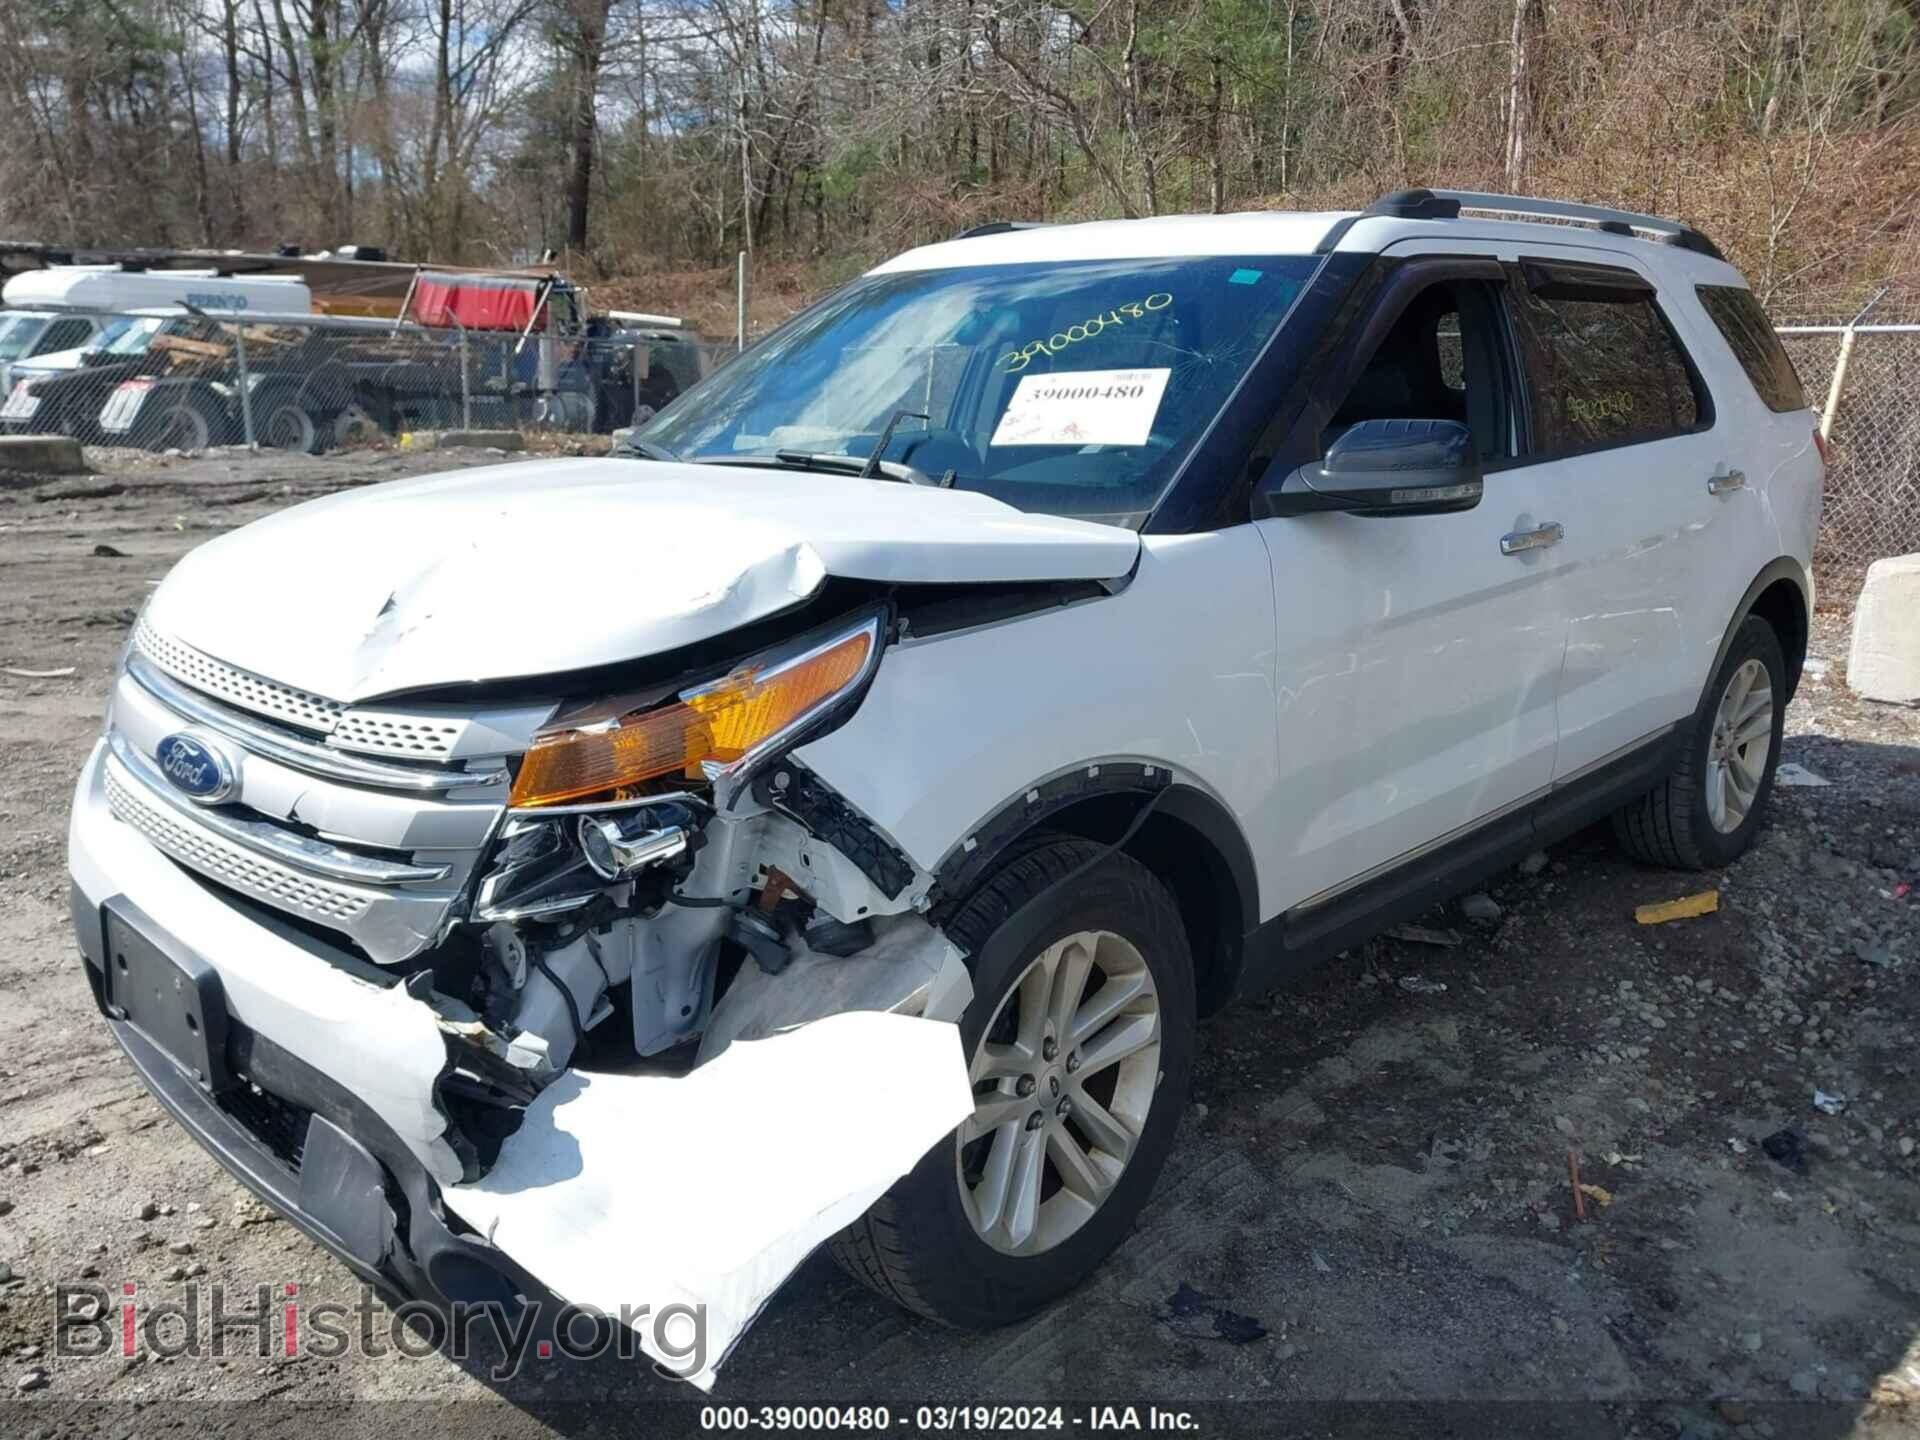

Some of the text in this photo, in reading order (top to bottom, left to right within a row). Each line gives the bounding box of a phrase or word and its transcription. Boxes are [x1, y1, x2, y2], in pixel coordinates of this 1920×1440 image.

[996, 293, 1173, 373] 39000480
[1032, 385, 1145, 400] 39000480
[164, 740, 207, 786] Ford
